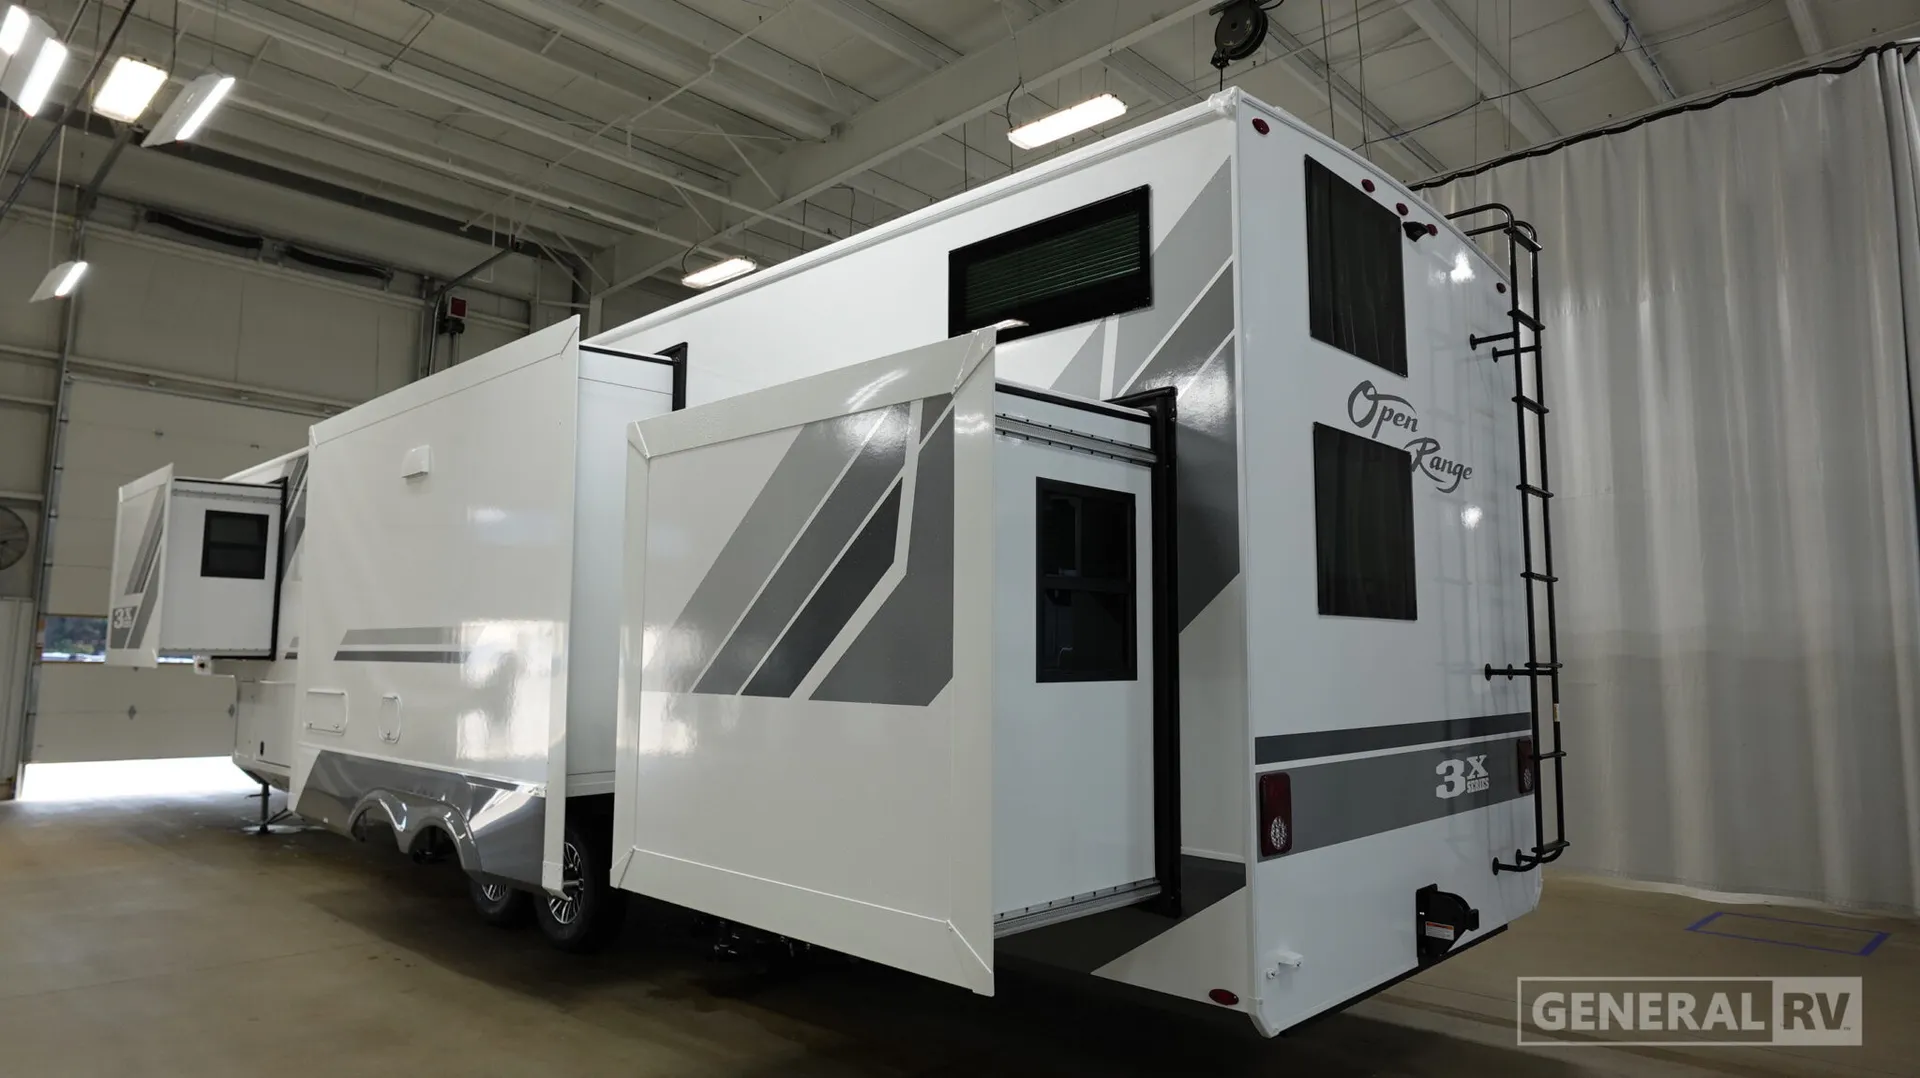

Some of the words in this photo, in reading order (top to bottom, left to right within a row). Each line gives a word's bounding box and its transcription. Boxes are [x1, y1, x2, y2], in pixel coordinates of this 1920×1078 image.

[1348, 380, 1418, 439] Open
[1403, 437, 1473, 494] Range
[1466, 777, 1489, 794] SERIES
